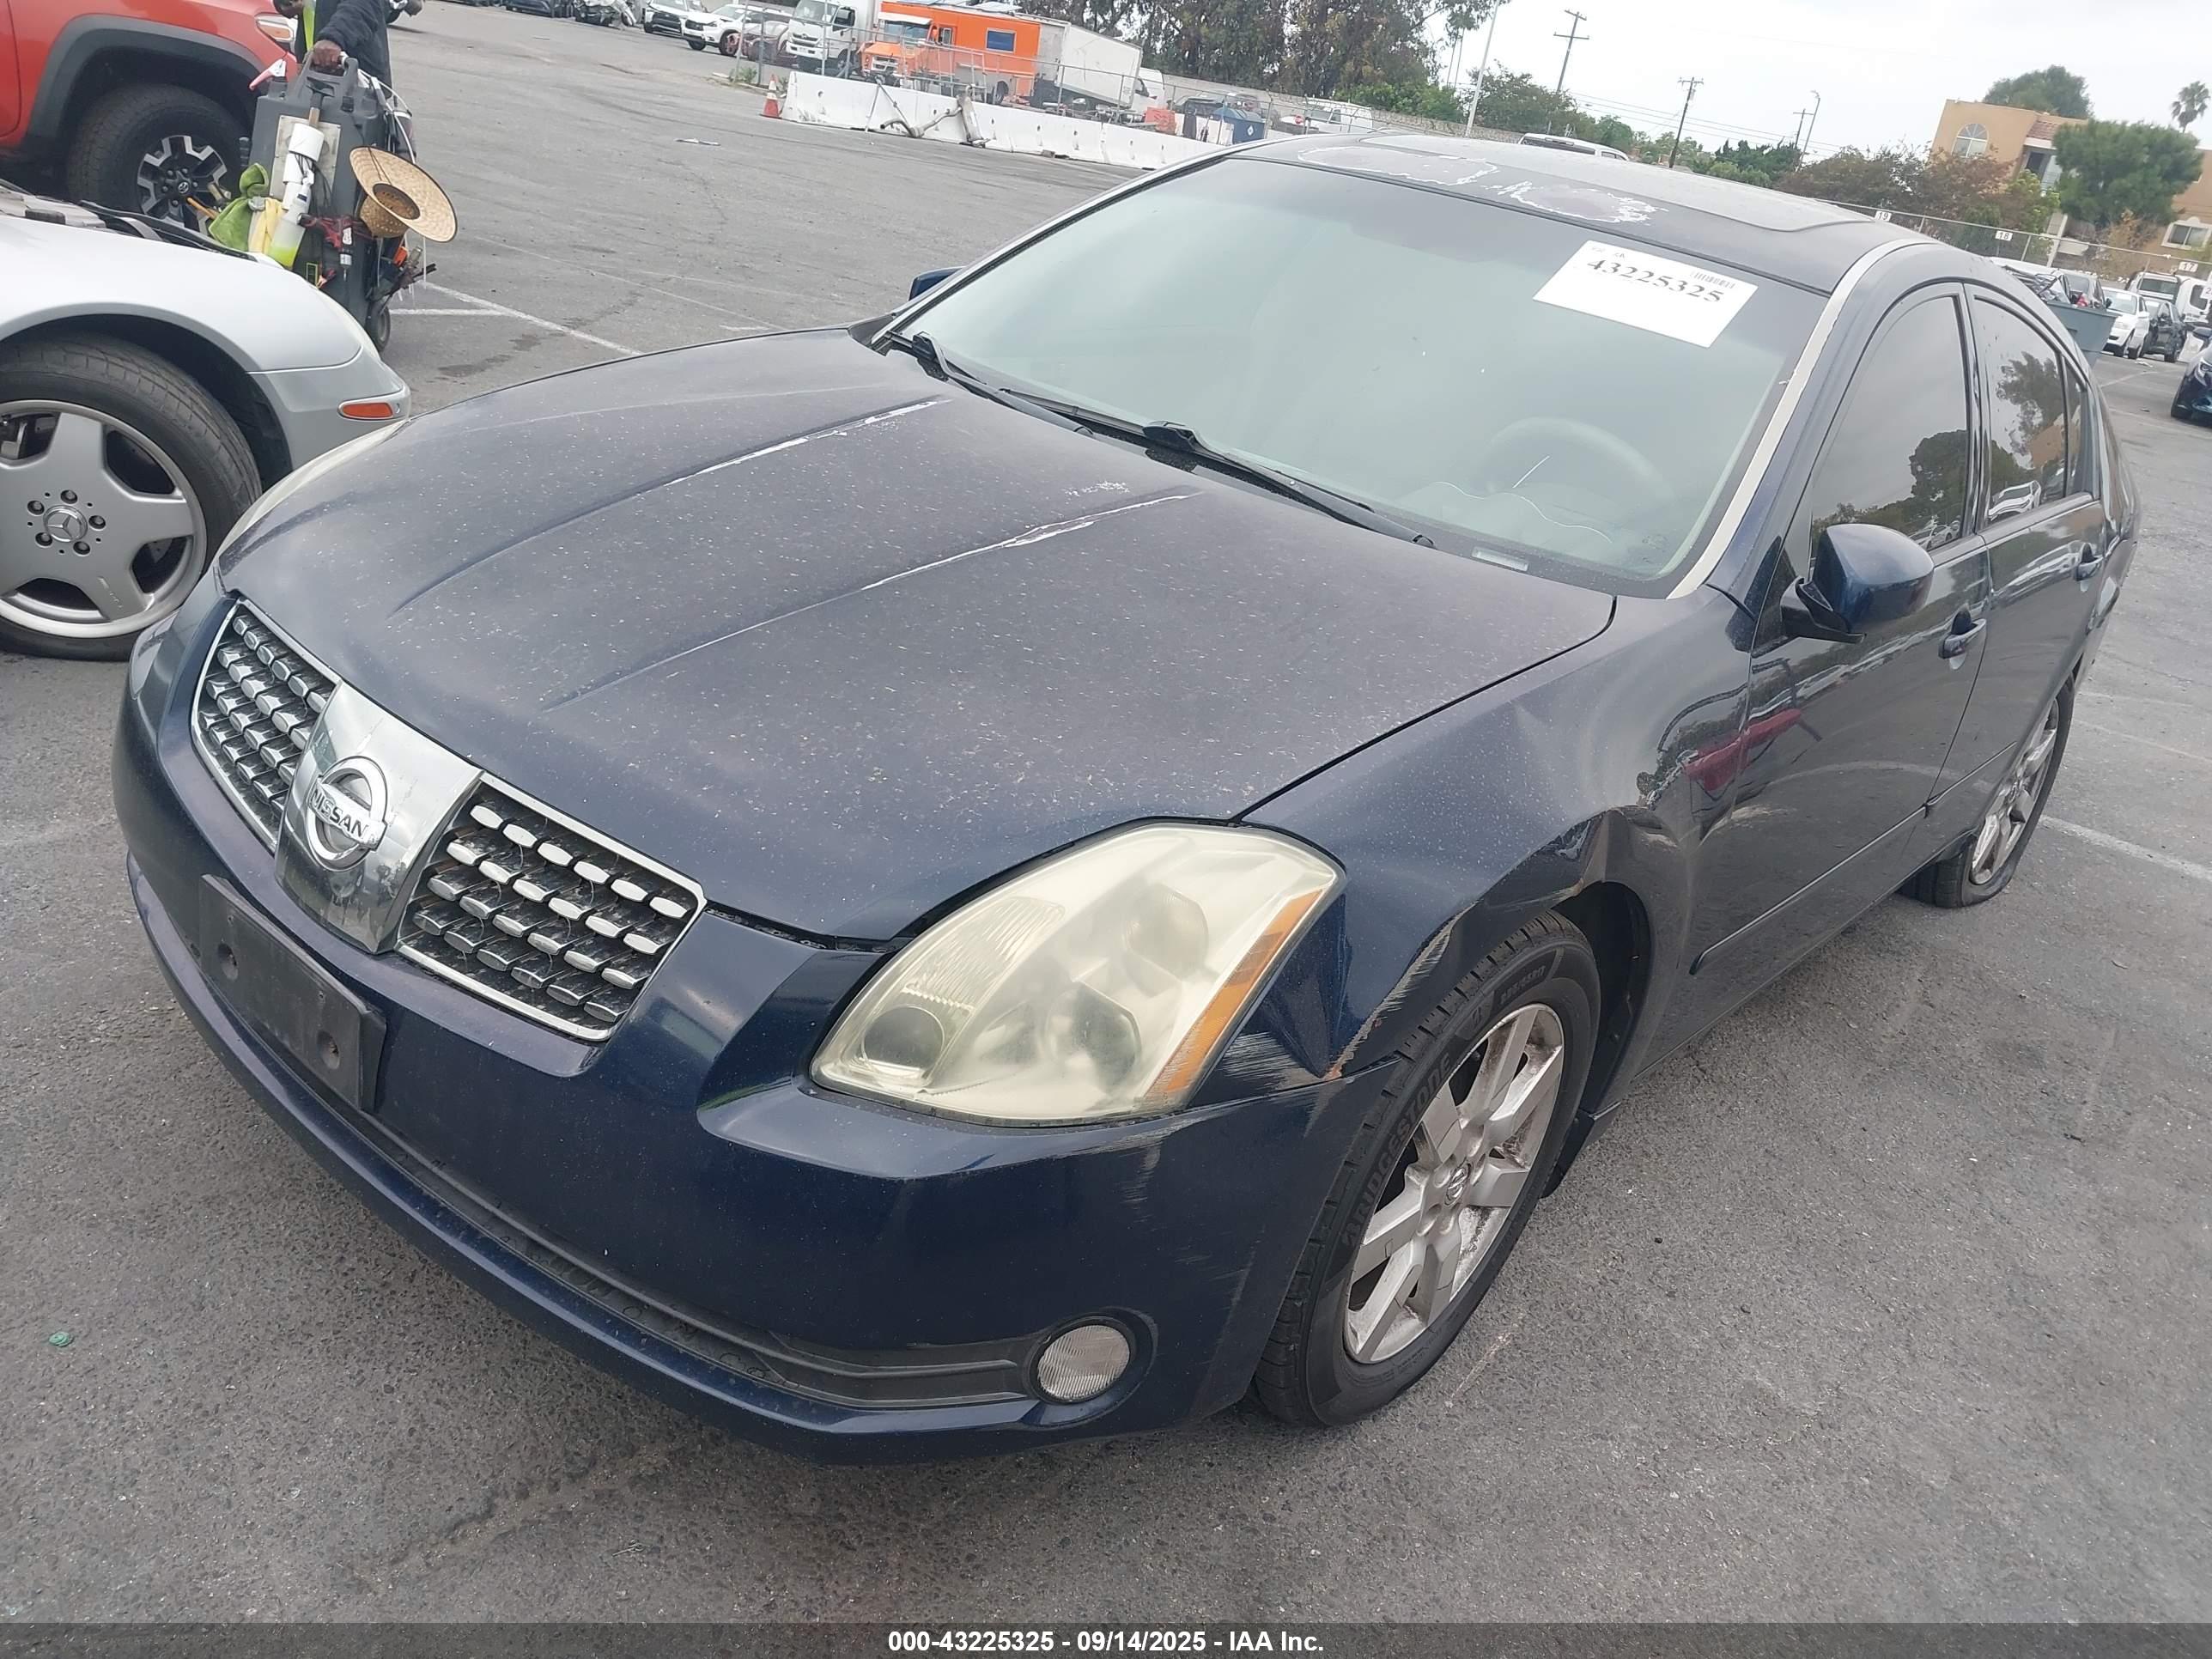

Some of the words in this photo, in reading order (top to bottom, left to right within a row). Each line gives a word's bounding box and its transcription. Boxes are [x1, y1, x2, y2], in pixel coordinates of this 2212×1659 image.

[1587, 259, 1725, 302] 43225325
[310, 788, 369, 838] NISSAN
[1342, 1052, 1452, 1245] BRIDGESTONE
